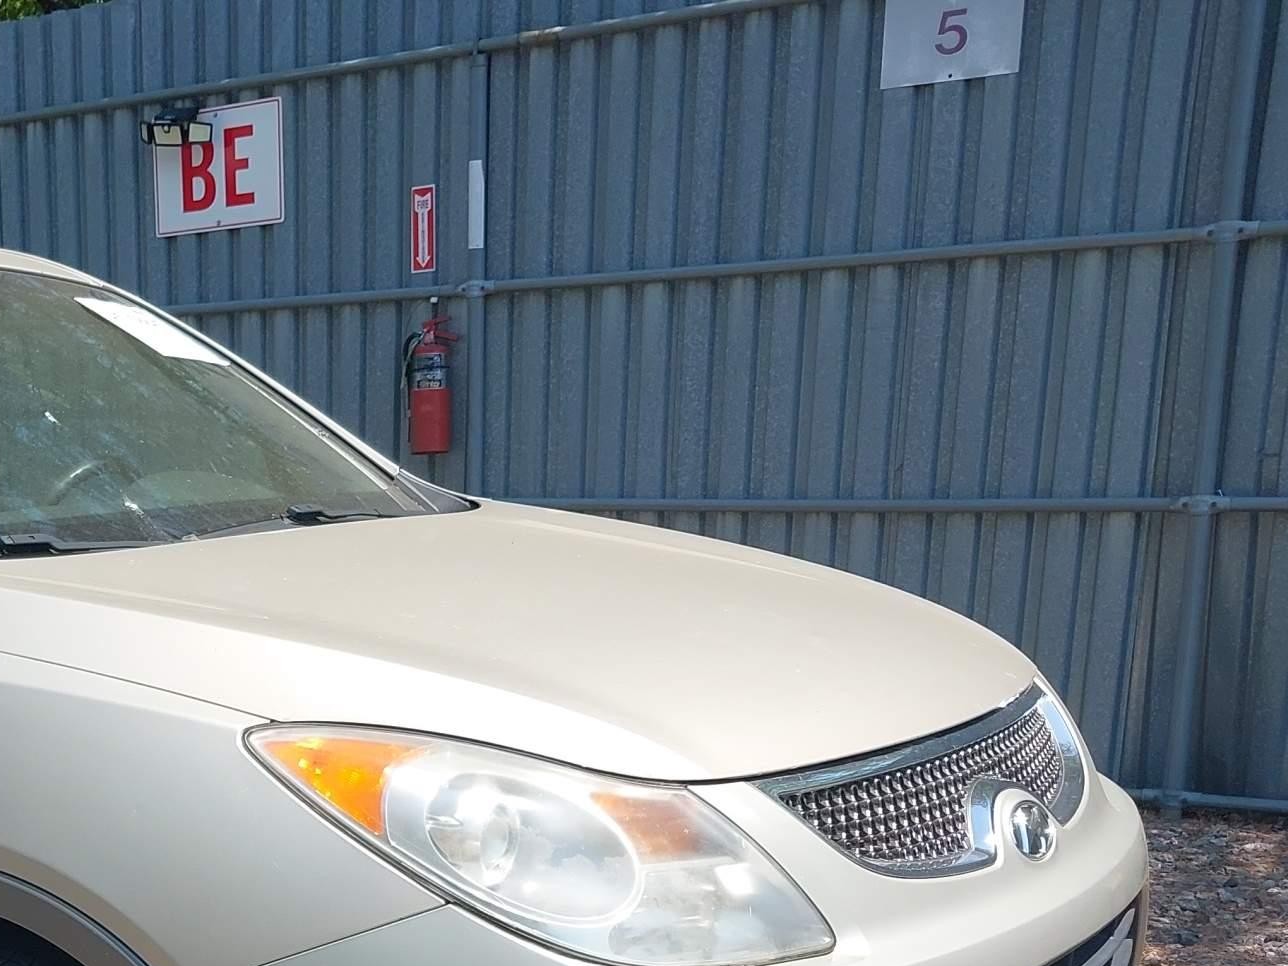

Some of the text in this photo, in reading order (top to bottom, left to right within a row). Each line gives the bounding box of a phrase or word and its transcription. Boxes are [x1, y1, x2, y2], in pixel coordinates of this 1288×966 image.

[934, 8, 968, 56] 5
[181, 123, 256, 214] BE
[416, 199, 429, 210] FIRE
